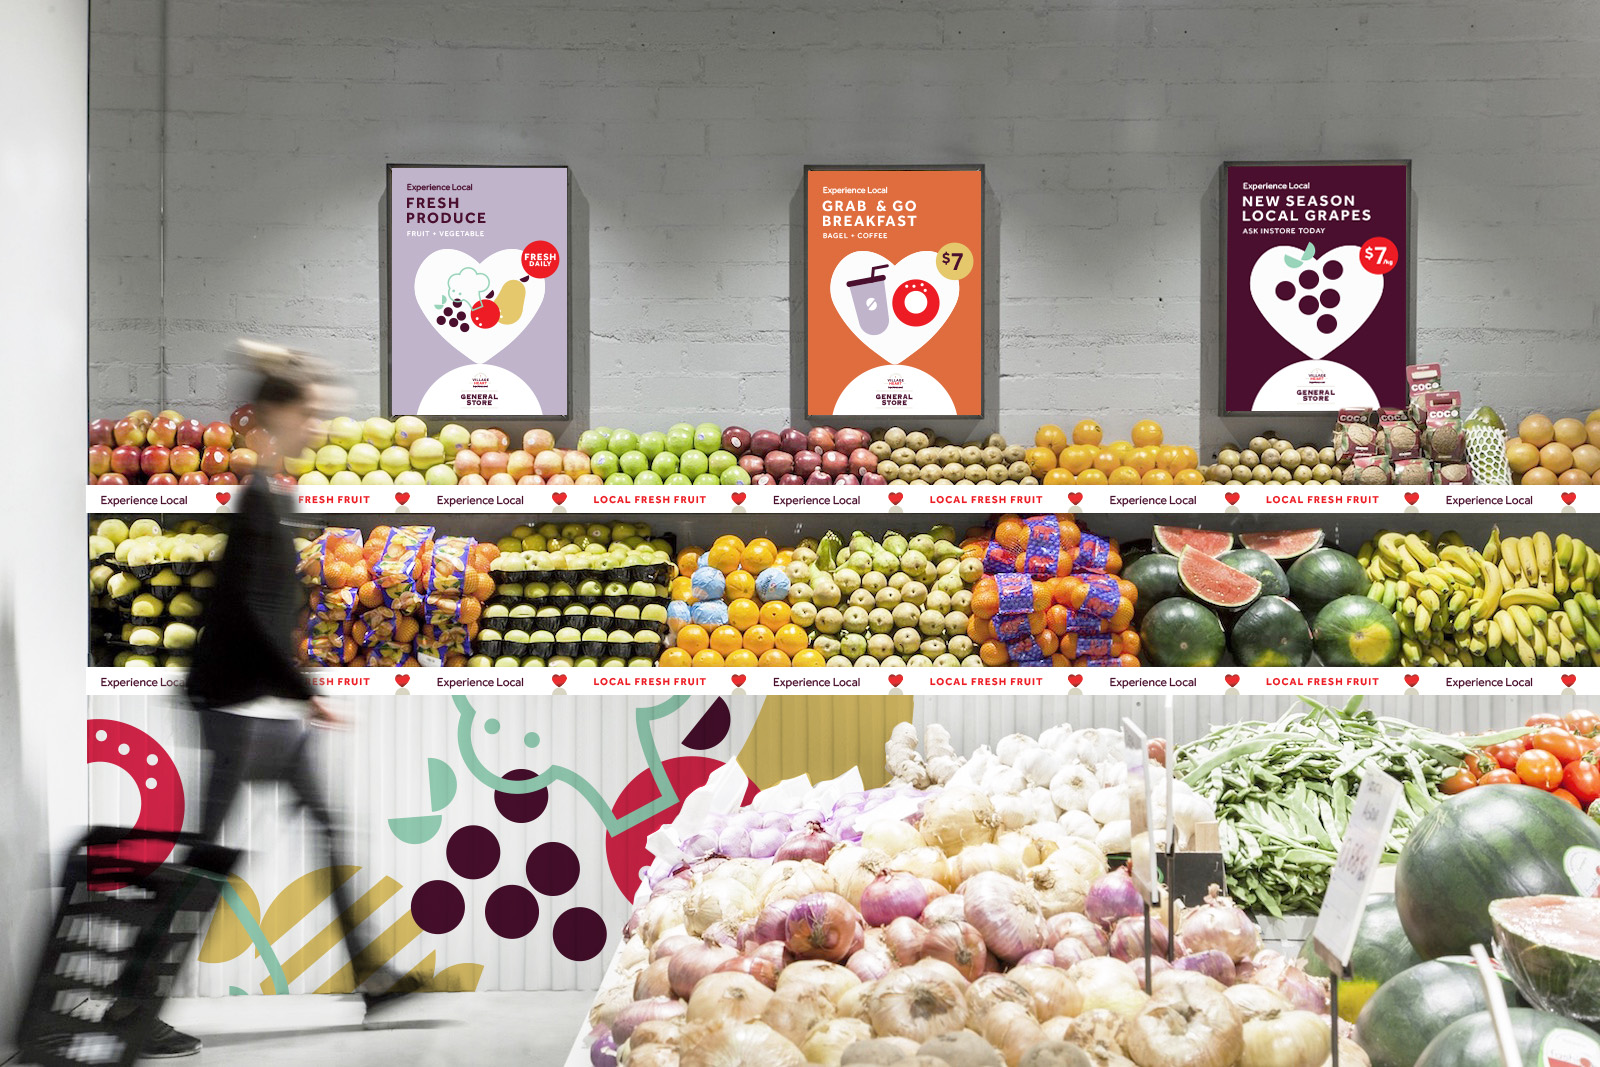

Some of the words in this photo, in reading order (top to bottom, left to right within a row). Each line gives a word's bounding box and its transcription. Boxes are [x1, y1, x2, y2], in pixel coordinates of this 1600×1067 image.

[406, 183, 450, 192] Experience
[452, 183, 473, 191] Local
[822, 186, 866, 195] Experience
[868, 186, 888, 194] Local
[1243, 182, 1288, 191] Experience
[1289, 182, 1311, 190] Local
[406, 197, 460, 209] FRESH
[822, 200, 867, 212] GRAB
[876, 200, 887, 212] &
[892, 200, 917, 212] GO
[1242, 195, 1281, 207] NEW
[1285, 195, 1355, 207] SEASON
[406, 212, 487, 224] PRODUCE
[822, 215, 918, 227] BREAKFAST
[1242, 210, 1299, 222] LOCAL
[1305, 209, 1371, 222] GRAPES
[1242, 227, 1259, 235] ASK
[1260, 227, 1296, 235] INSTORE
[1298, 227, 1326, 235] TODAY
[524, 253, 557, 261] FRESH
[942, 252, 964, 271] $7
[101, 495, 158, 508] Experience
[161, 495, 188, 505] Local
[298, 495, 334, 505] FRESH
[338, 495, 371, 505] FRUIT
[437, 495, 494, 508] Experience
[497, 495, 524, 505] Local
[593, 495, 631, 505] LOCAL
[634, 495, 671, 505] FRESH
[674, 495, 707, 505] FRUIT
[774, 495, 831, 508] Experience
[834, 495, 861, 505] Local
[929, 495, 967, 505] LOCAL
[970, 495, 1007, 505] FRESH
[1010, 495, 1043, 505] FRUIT
[1110, 495, 1167, 508] Experience
[1170, 495, 1197, 505] Local
[1265, 495, 1303, 505] LOCAL
[1306, 495, 1343, 505] FRESH
[1346, 495, 1379, 505] FRUIT
[1446, 495, 1503, 508] Experience
[1506, 495, 1533, 505] Local
[101, 677, 158, 690] Experience
[160, 677, 185, 687] Loca
[304, 677, 334, 687] RESH
[338, 677, 371, 687] FRUIT
[437, 677, 494, 690] Experience
[497, 677, 524, 687] Local
[593, 677, 631, 687] LOCAL
[634, 677, 671, 687] FRESH
[674, 677, 707, 687] FRUIT
[774, 677, 831, 690] Experience
[834, 677, 861, 687] Local
[929, 677, 967, 687] LOCAL
[970, 677, 1007, 687] FRESH
[1010, 677, 1043, 687] FRUIT
[1110, 677, 1167, 690] Experience
[1170, 677, 1197, 687] Local
[1265, 677, 1303, 687] LOCAL
[1306, 677, 1343, 687] FRESH
[1346, 677, 1379, 687] FRUIT
[1446, 677, 1503, 690] Experience
[1506, 677, 1533, 687] Local
